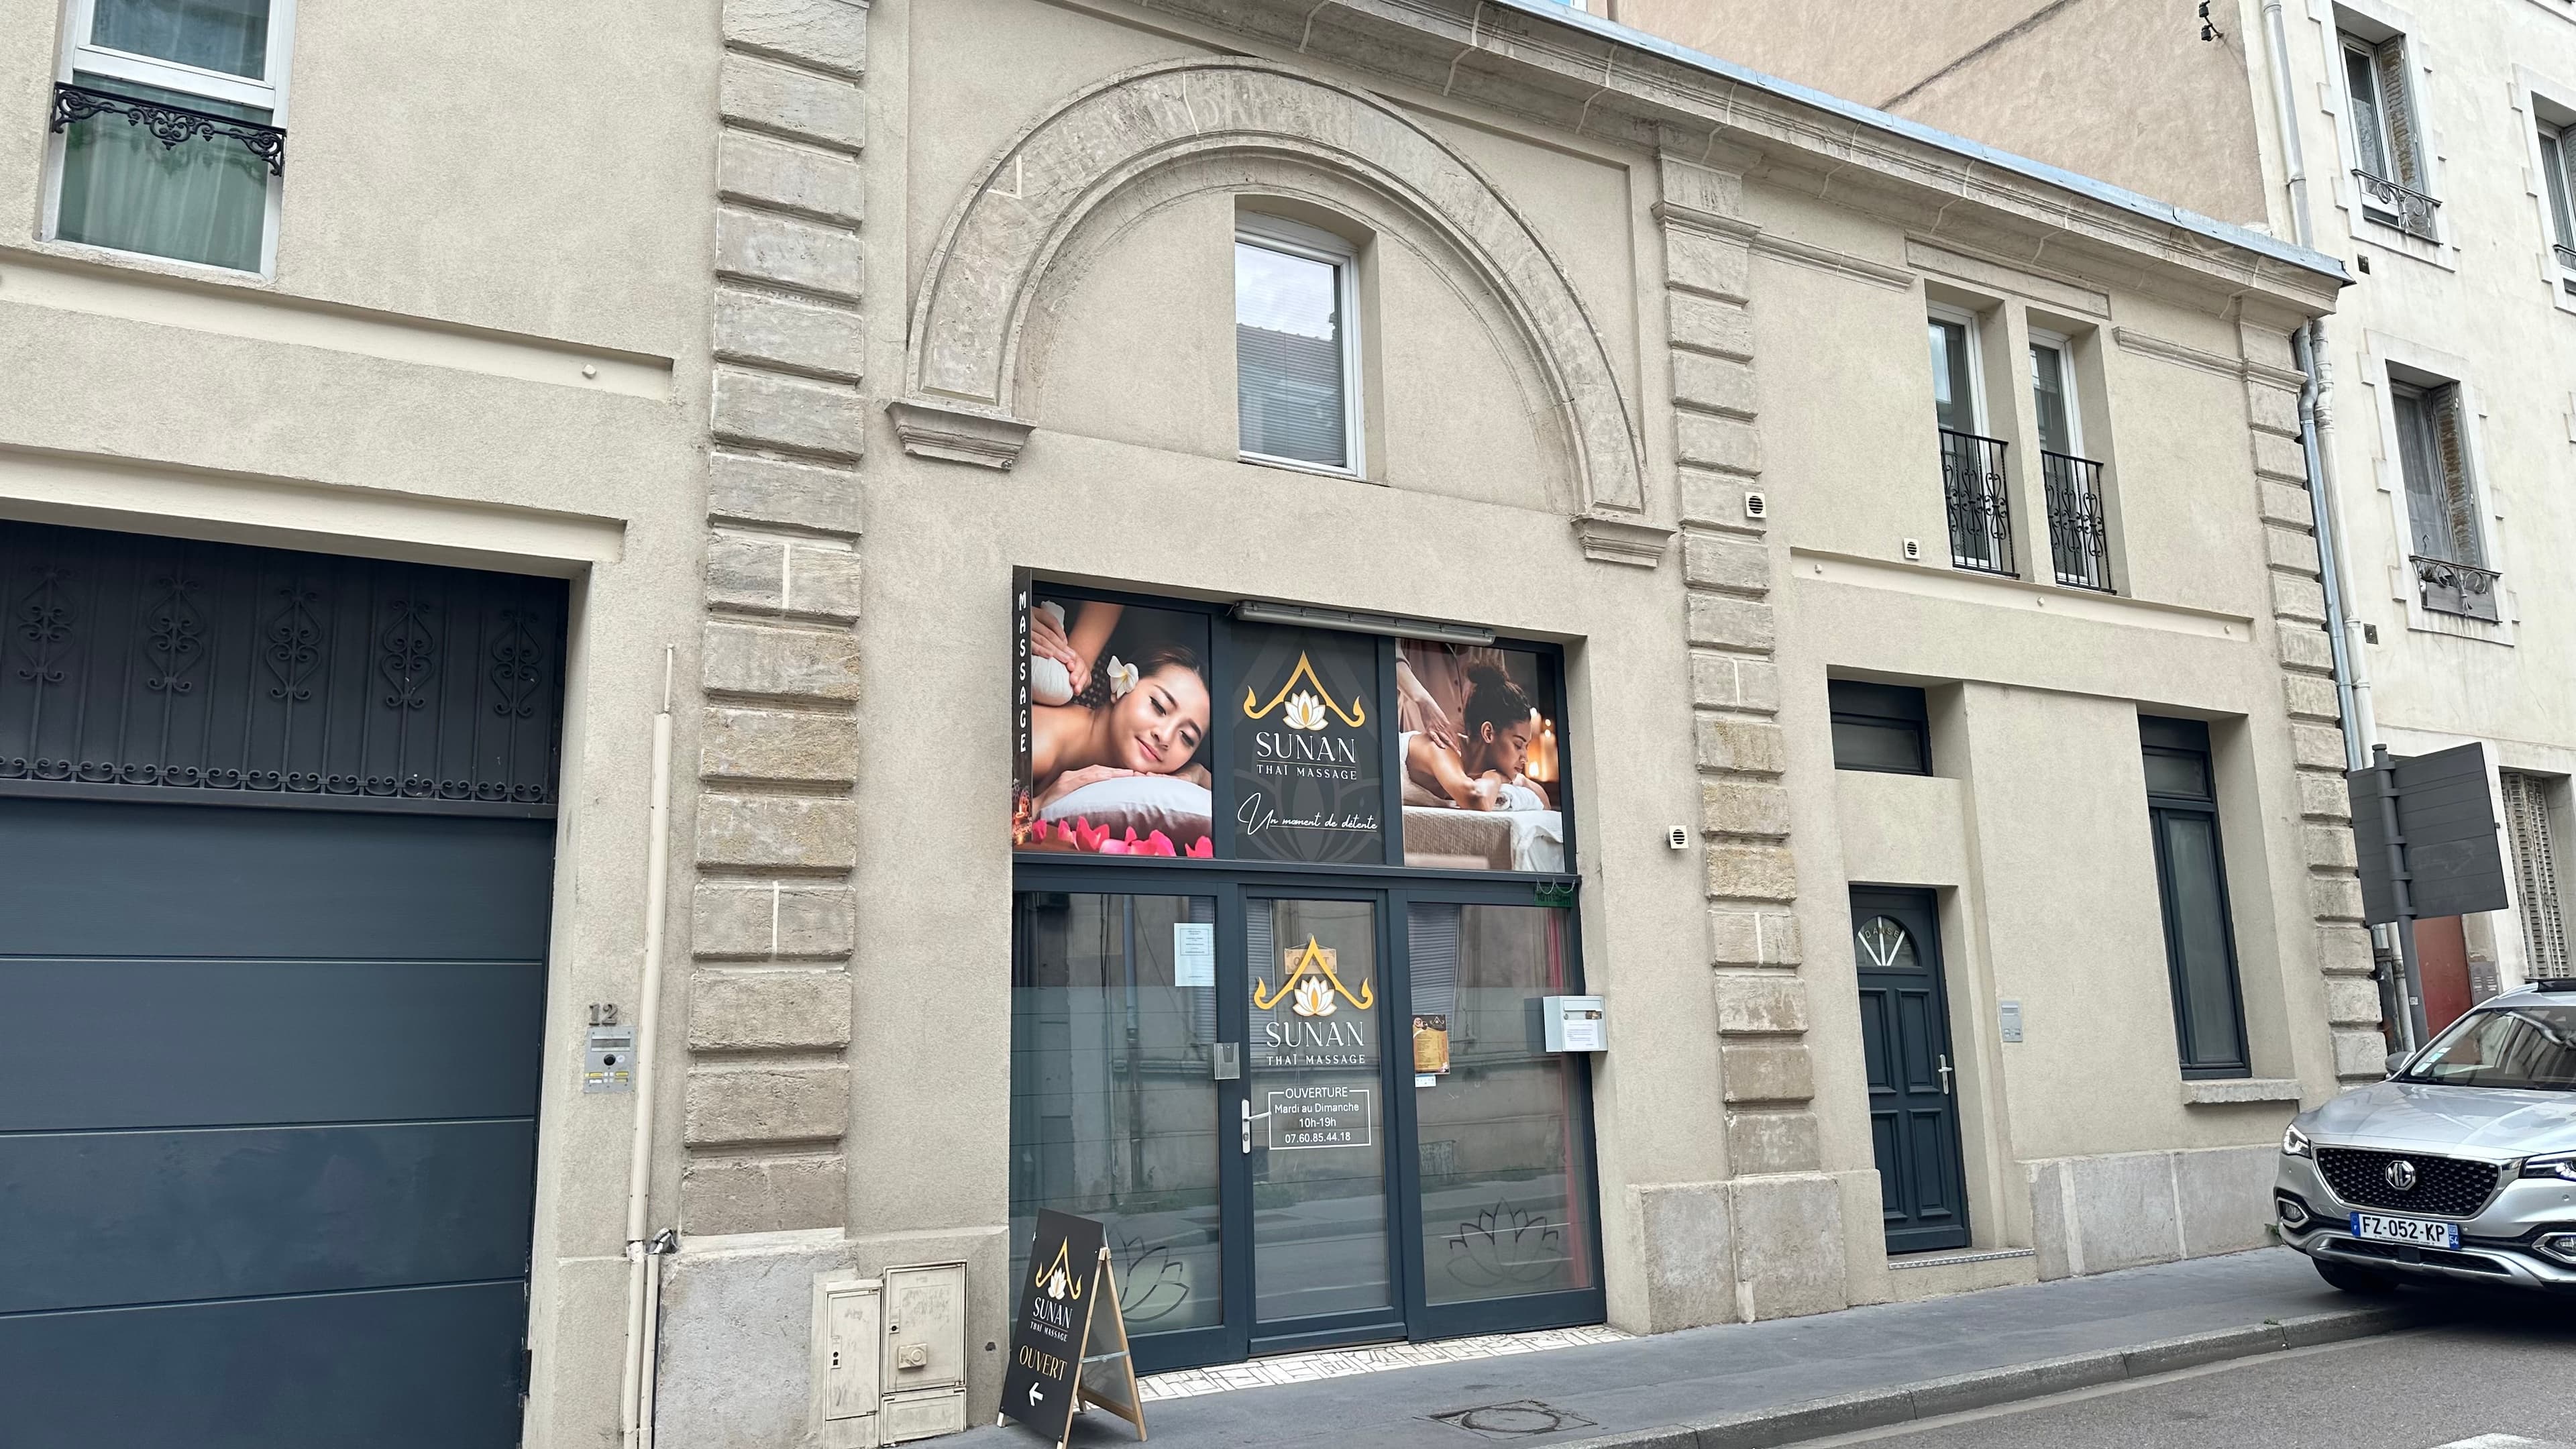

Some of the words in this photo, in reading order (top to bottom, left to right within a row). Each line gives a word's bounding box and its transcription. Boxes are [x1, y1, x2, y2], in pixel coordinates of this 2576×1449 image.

[1019, 591, 1027, 752] MASSAGE
[1256, 731, 1356, 763] SUNAN
[1256, 764, 1288, 775] THAÏ
[1297, 767, 1357, 780] MASSAGE
[1237, 792, 1278, 835] Un
[1282, 812, 1321, 826] moment
[1324, 813, 1337, 827] de
[1341, 814, 1378, 829] détente
[589, 1003, 619, 1025] 12
[1266, 1022, 1364, 1048] SUNAN
[1267, 1054, 1297, 1065] THAÏ
[1305, 1054, 1366, 1065] MASSAGE
[1285, 1087, 1348, 1099] OUVERTURE
[1275, 1104, 1299, 1114] Mardi
[1301, 1105, 1313, 1113] au
[1315, 1102, 1359, 1113] Dimanche
[1299, 1117, 1336, 1128] 10h-19h
[1285, 1132, 1351, 1144] 07.60.85.44.18
[2387, 1162, 2412, 1187] MG
[2362, 1216, 2445, 1242] FZ-052-KP
[2449, 1236, 2459, 1245] 54
[1033, 1297, 1073, 1328] SUNAN
[1044, 1327, 1067, 1342] MASSAGE
[1020, 1346, 1067, 1381] OUVERT
